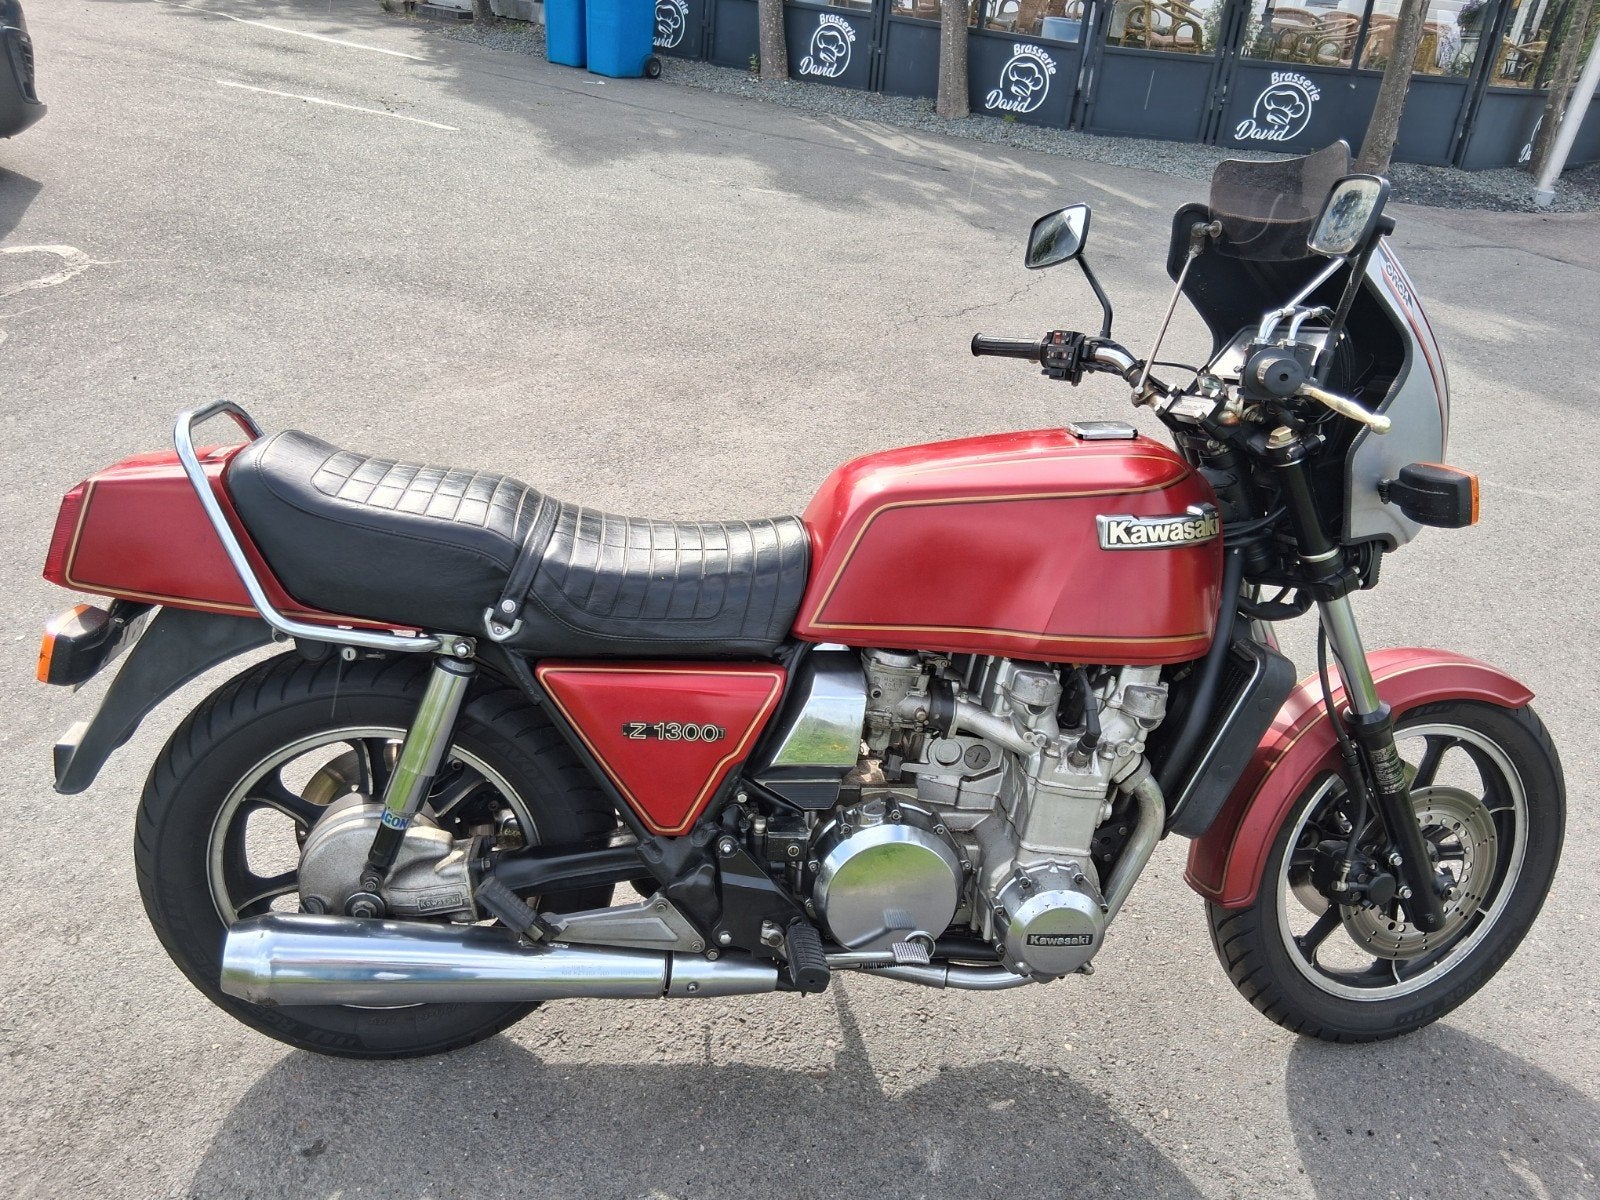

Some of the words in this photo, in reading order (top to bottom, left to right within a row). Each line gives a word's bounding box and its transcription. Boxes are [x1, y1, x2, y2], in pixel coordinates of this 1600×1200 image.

[819, 13, 856, 41] Brasserie
[652, 35, 674, 49] avid
[799, 56, 837, 78] David
[1013, 43, 1057, 75] Brasserie
[1271, 71, 1321, 102] Brasserie
[985, 89, 1032, 113] David
[1234, 119, 1290, 141] David
[1109, 512, 1219, 544] Kawasaki
[629, 722, 647, 740] Z
[653, 722, 720, 743] 1300
[1030, 935, 1090, 945] Kawasaki
